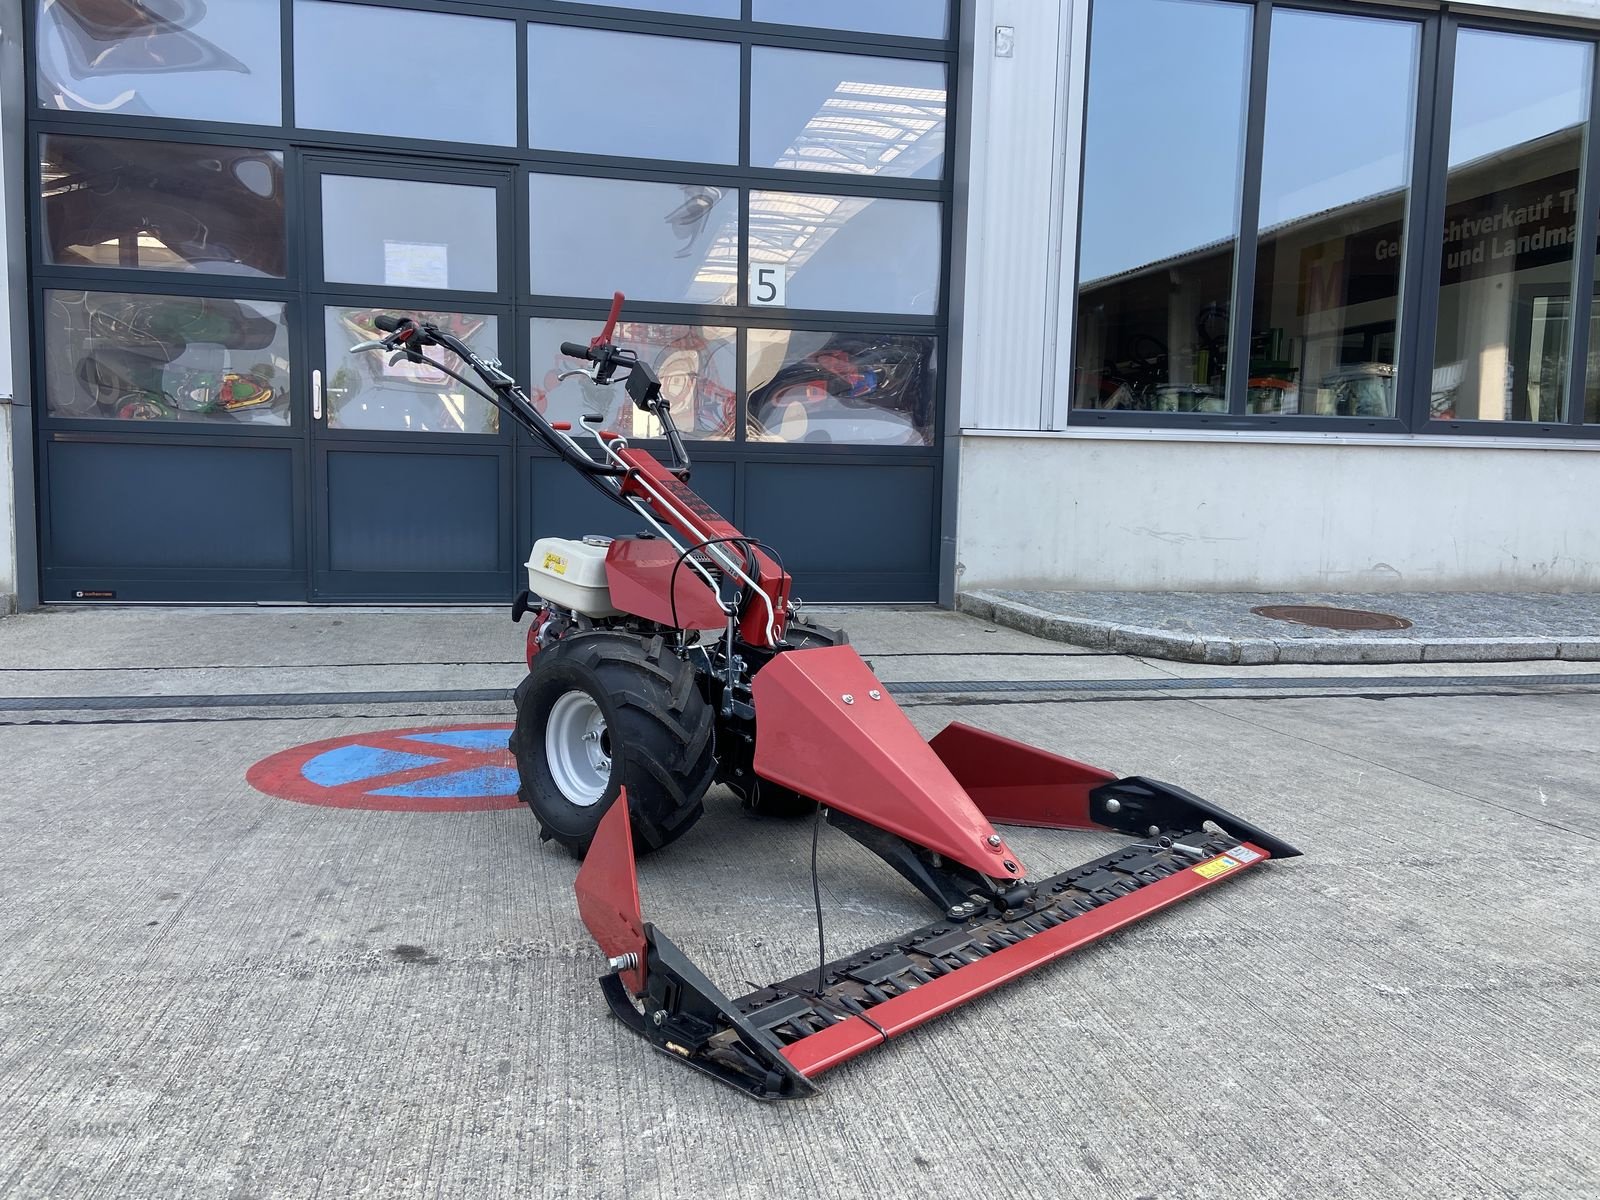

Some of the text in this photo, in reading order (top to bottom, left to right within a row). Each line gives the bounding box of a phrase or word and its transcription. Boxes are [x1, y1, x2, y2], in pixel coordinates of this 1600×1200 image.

[1447, 225, 1577, 269] und Landma
[757, 269, 777, 302] 5
